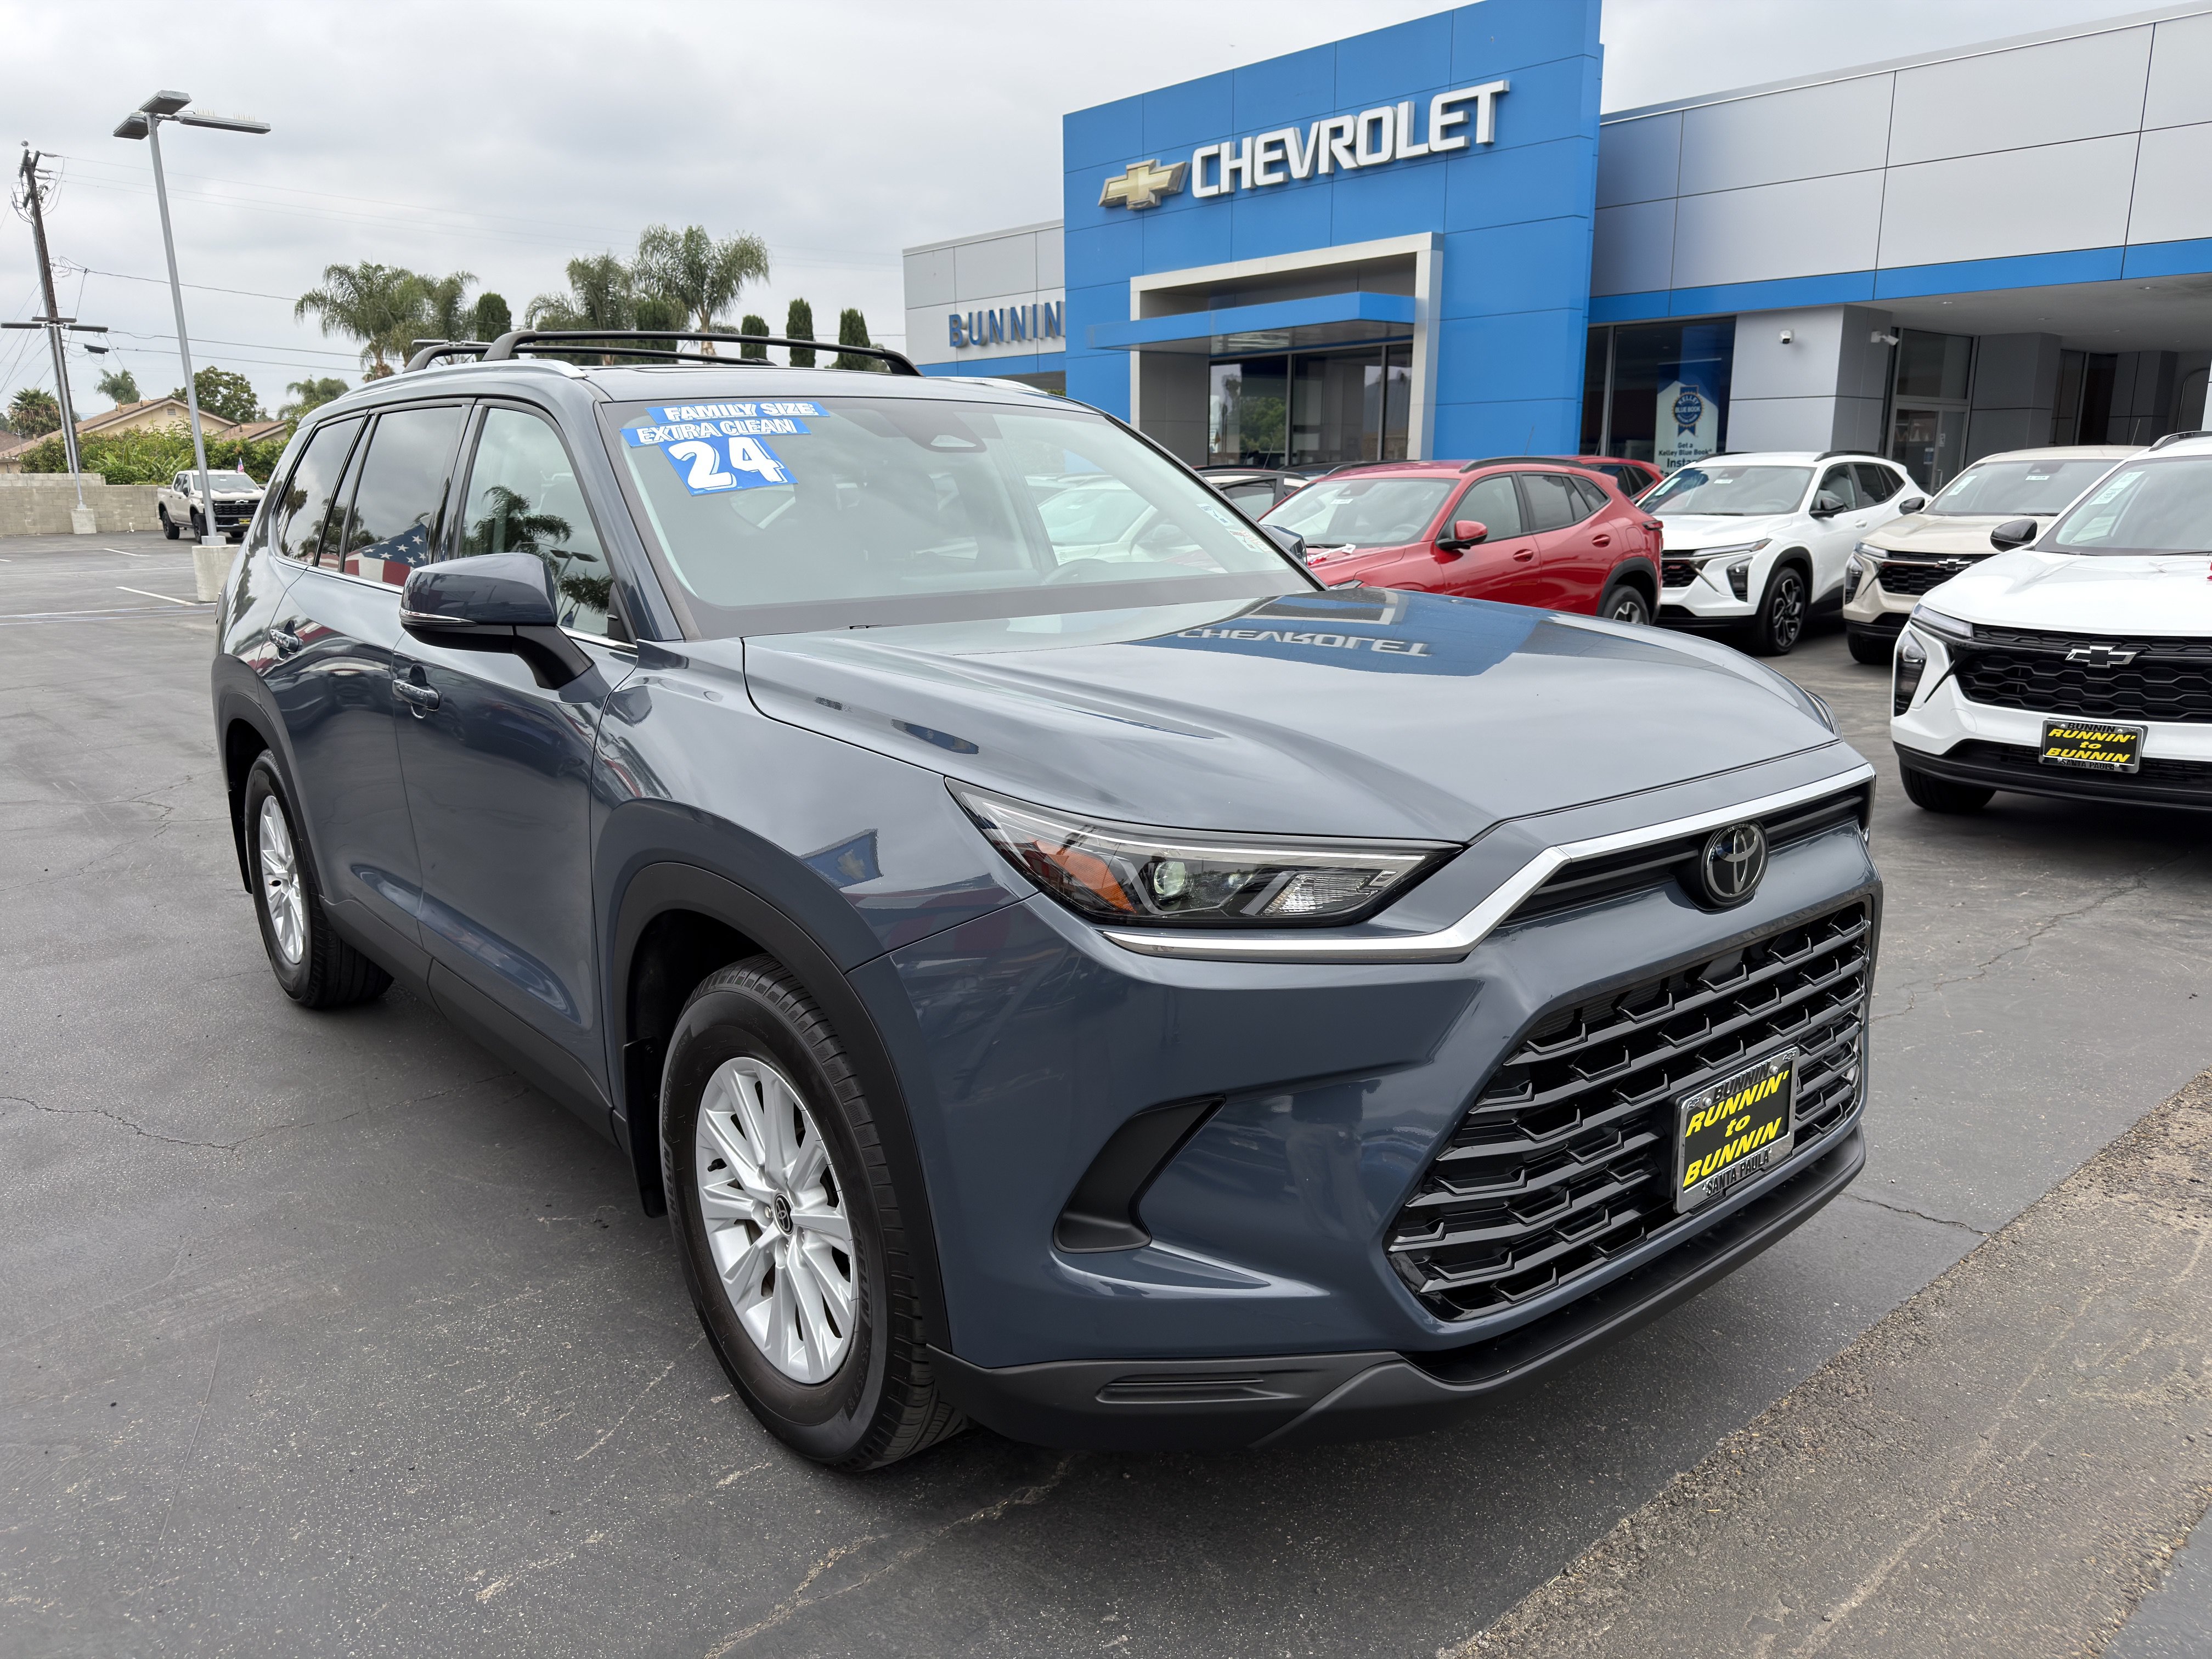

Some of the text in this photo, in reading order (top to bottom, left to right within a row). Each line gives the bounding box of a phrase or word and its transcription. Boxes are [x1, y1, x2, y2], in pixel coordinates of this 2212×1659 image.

[1192, 80, 1510, 198] CHEVROLET
[949, 301, 1065, 347] BUNNIN
[663, 403, 819, 421] FAMILY SIZE
[1678, 394, 1700, 405] KELLEY
[636, 419, 797, 445] EXTRA CLEAN
[668, 437, 788, 490] 24
[2048, 729, 2136, 743] RUNNIN'
[2068, 722, 2116, 732] BUNNIN
[2045, 748, 2130, 763] BUNNIN
[2061, 759, 2085, 768] SANTA
[1714, 1061, 1771, 1101] BUNNIN
[1685, 1070, 1790, 1137] RUNNIN'
[1725, 1115, 1751, 1137] to
[1683, 1117, 1782, 1187] BUNNIN
[1705, 1153, 1769, 1197] SANTA PAULA
